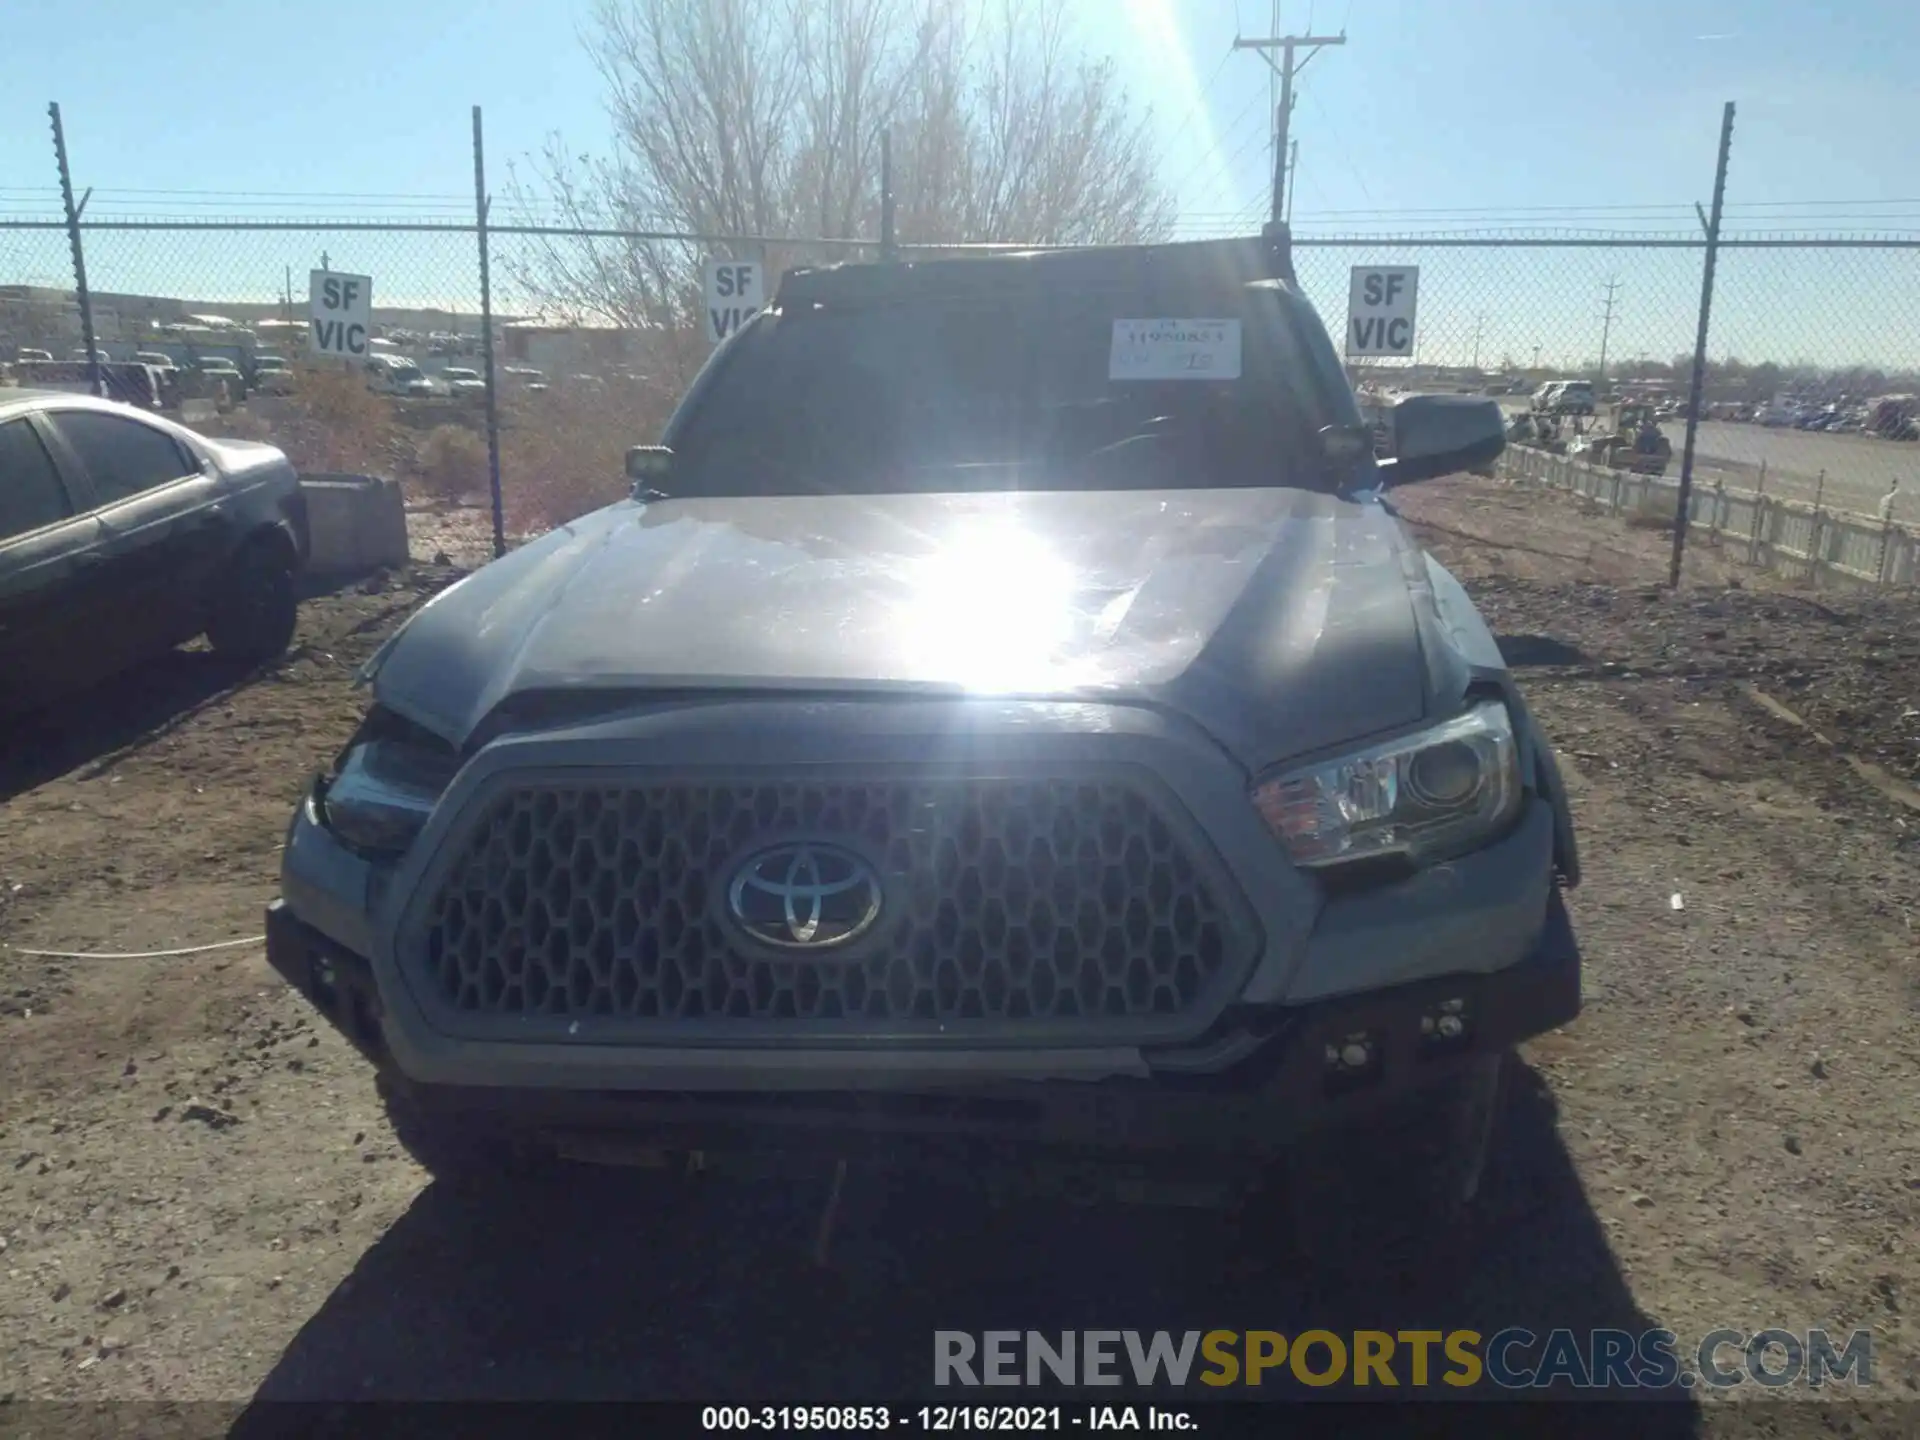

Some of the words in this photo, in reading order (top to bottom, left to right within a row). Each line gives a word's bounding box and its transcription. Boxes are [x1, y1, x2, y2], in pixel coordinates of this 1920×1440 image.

[322, 278, 360, 310] SF
[716, 266, 753, 297] SF
[1364, 273, 1405, 307] SF
[314, 317, 366, 354] VIC
[1353, 317, 1409, 351] VIC
